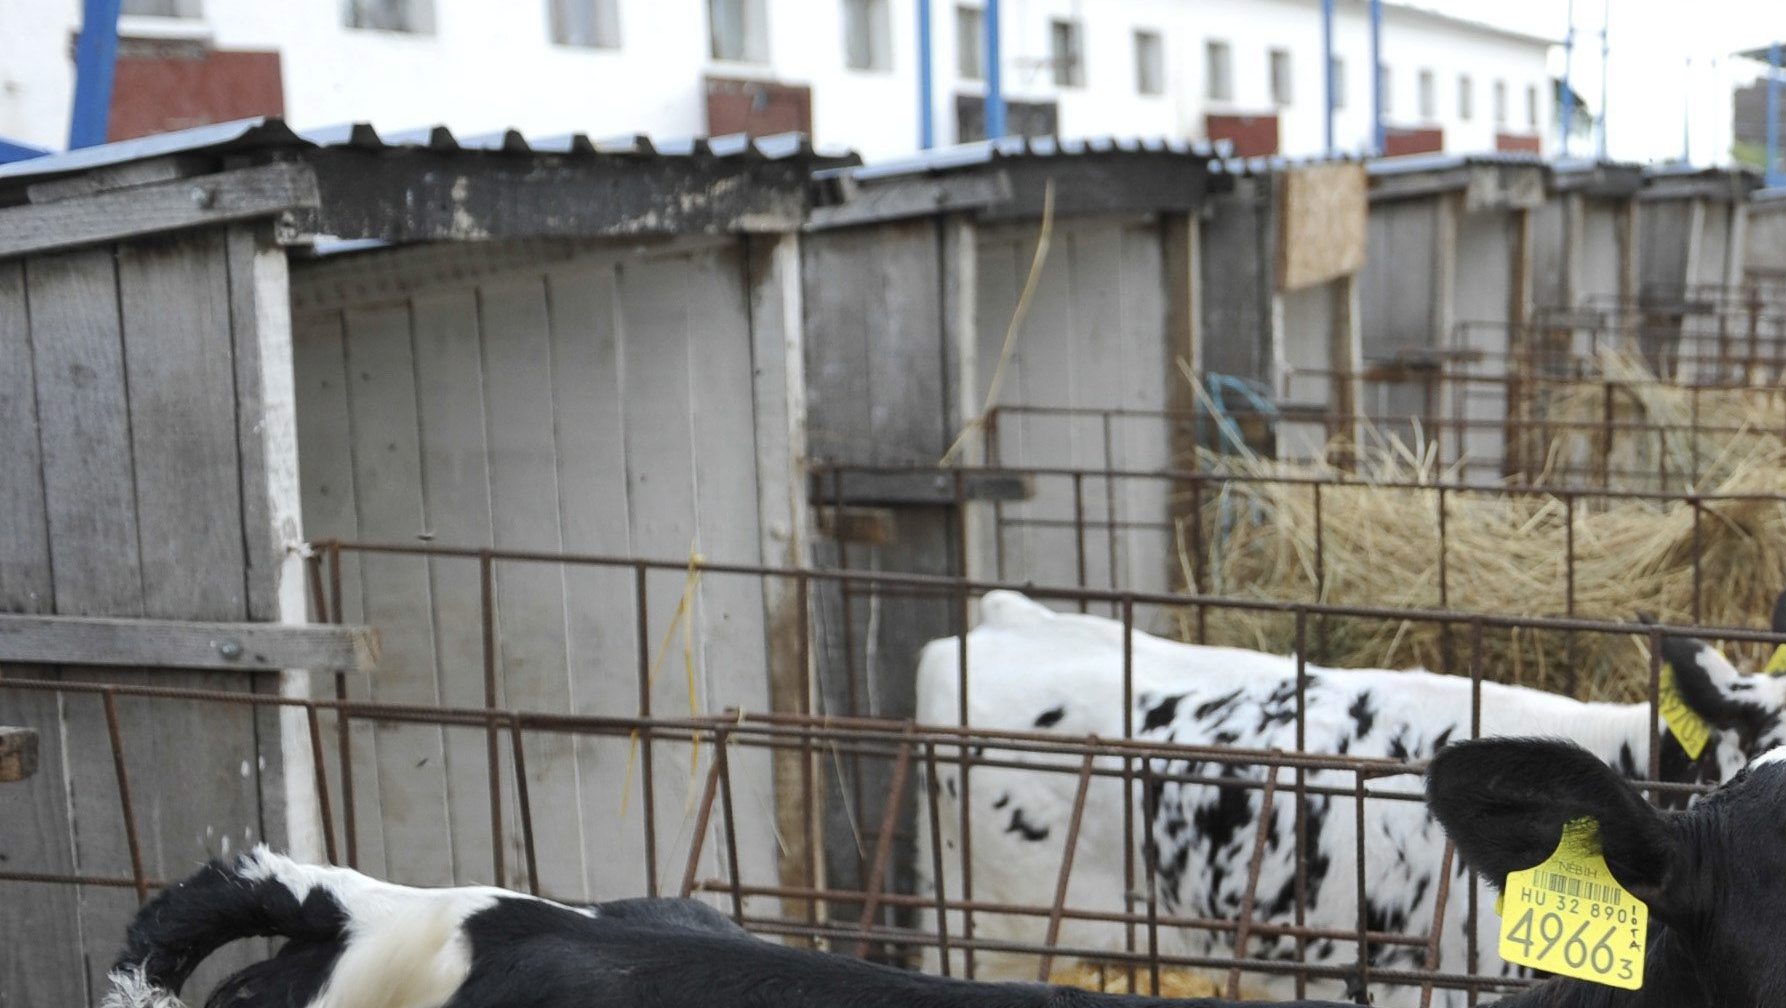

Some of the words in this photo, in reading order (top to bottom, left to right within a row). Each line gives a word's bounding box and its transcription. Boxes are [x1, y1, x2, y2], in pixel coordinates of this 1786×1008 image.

[1521, 887, 1546, 906] HU
[1556, 895, 1579, 914] 32
[1590, 904, 1627, 924] 890
